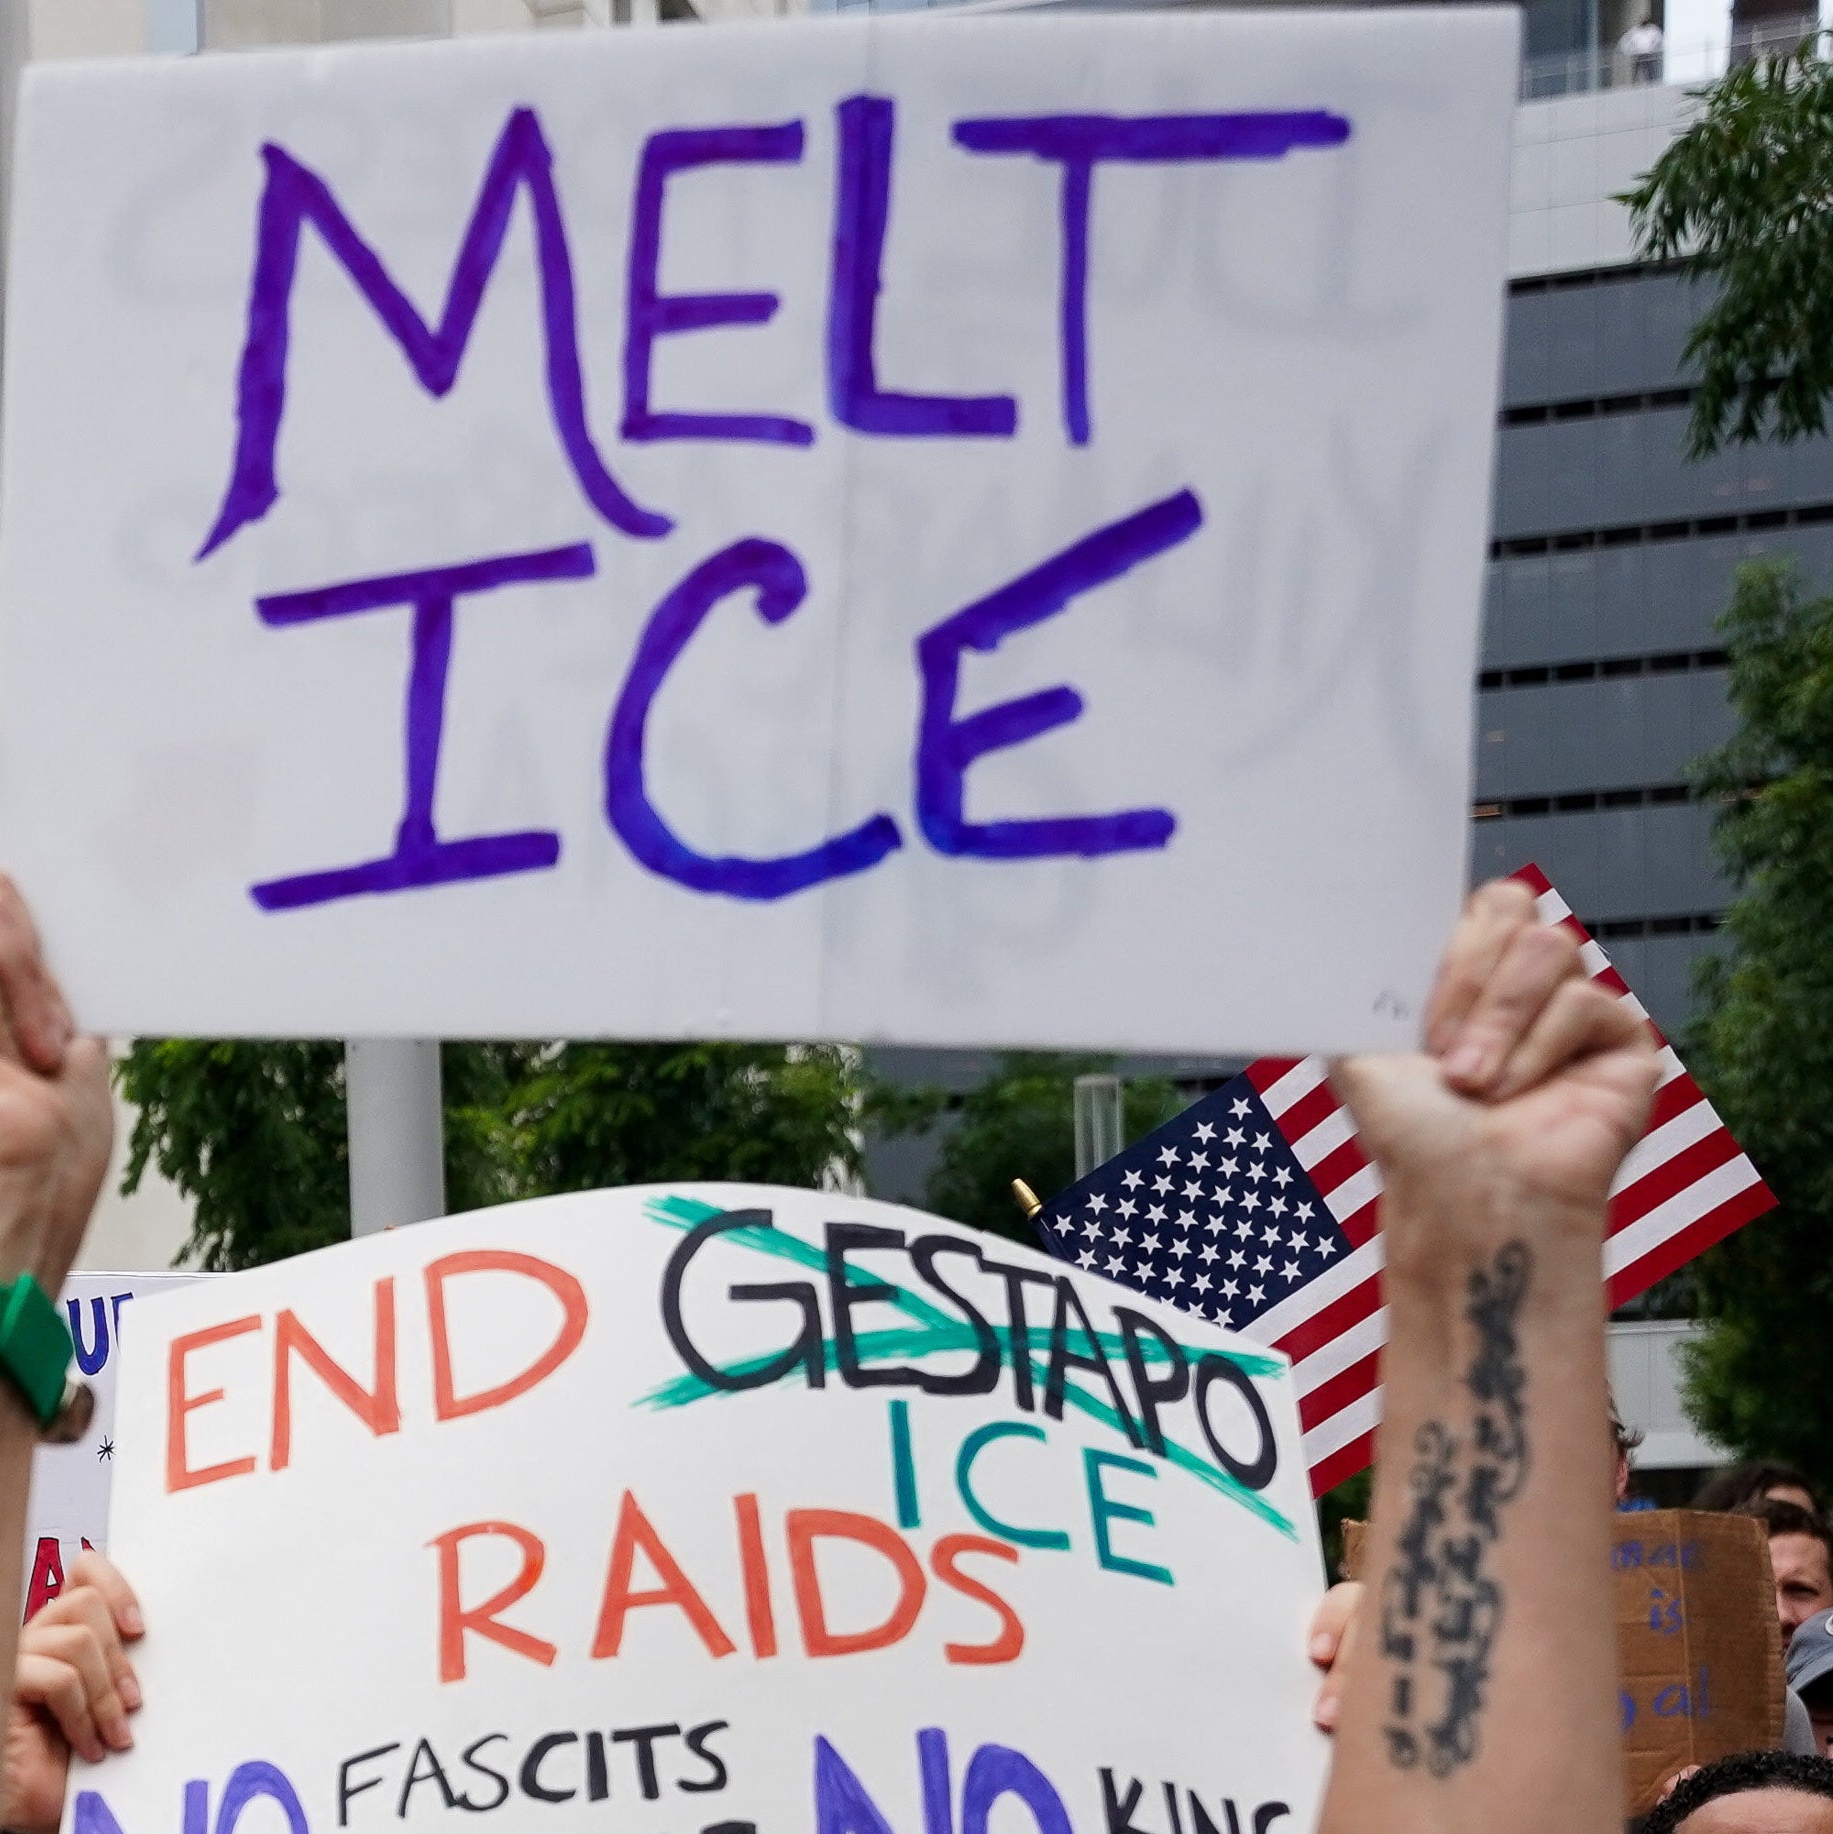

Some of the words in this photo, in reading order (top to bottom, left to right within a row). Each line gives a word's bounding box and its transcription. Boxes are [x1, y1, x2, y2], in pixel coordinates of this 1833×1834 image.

[193, 94, 1352, 563] MELT
[249, 487, 1203, 910] ICE
[166, 1251, 588, 1492] END
[661, 1209, 1279, 1490] GESTAPO
[426, 1489, 1025, 1683] RAIDS
[891, 1399, 1174, 1586] ICE
[1649, 1588, 1683, 1636] is
[338, 1720, 729, 1826] FASCITS
